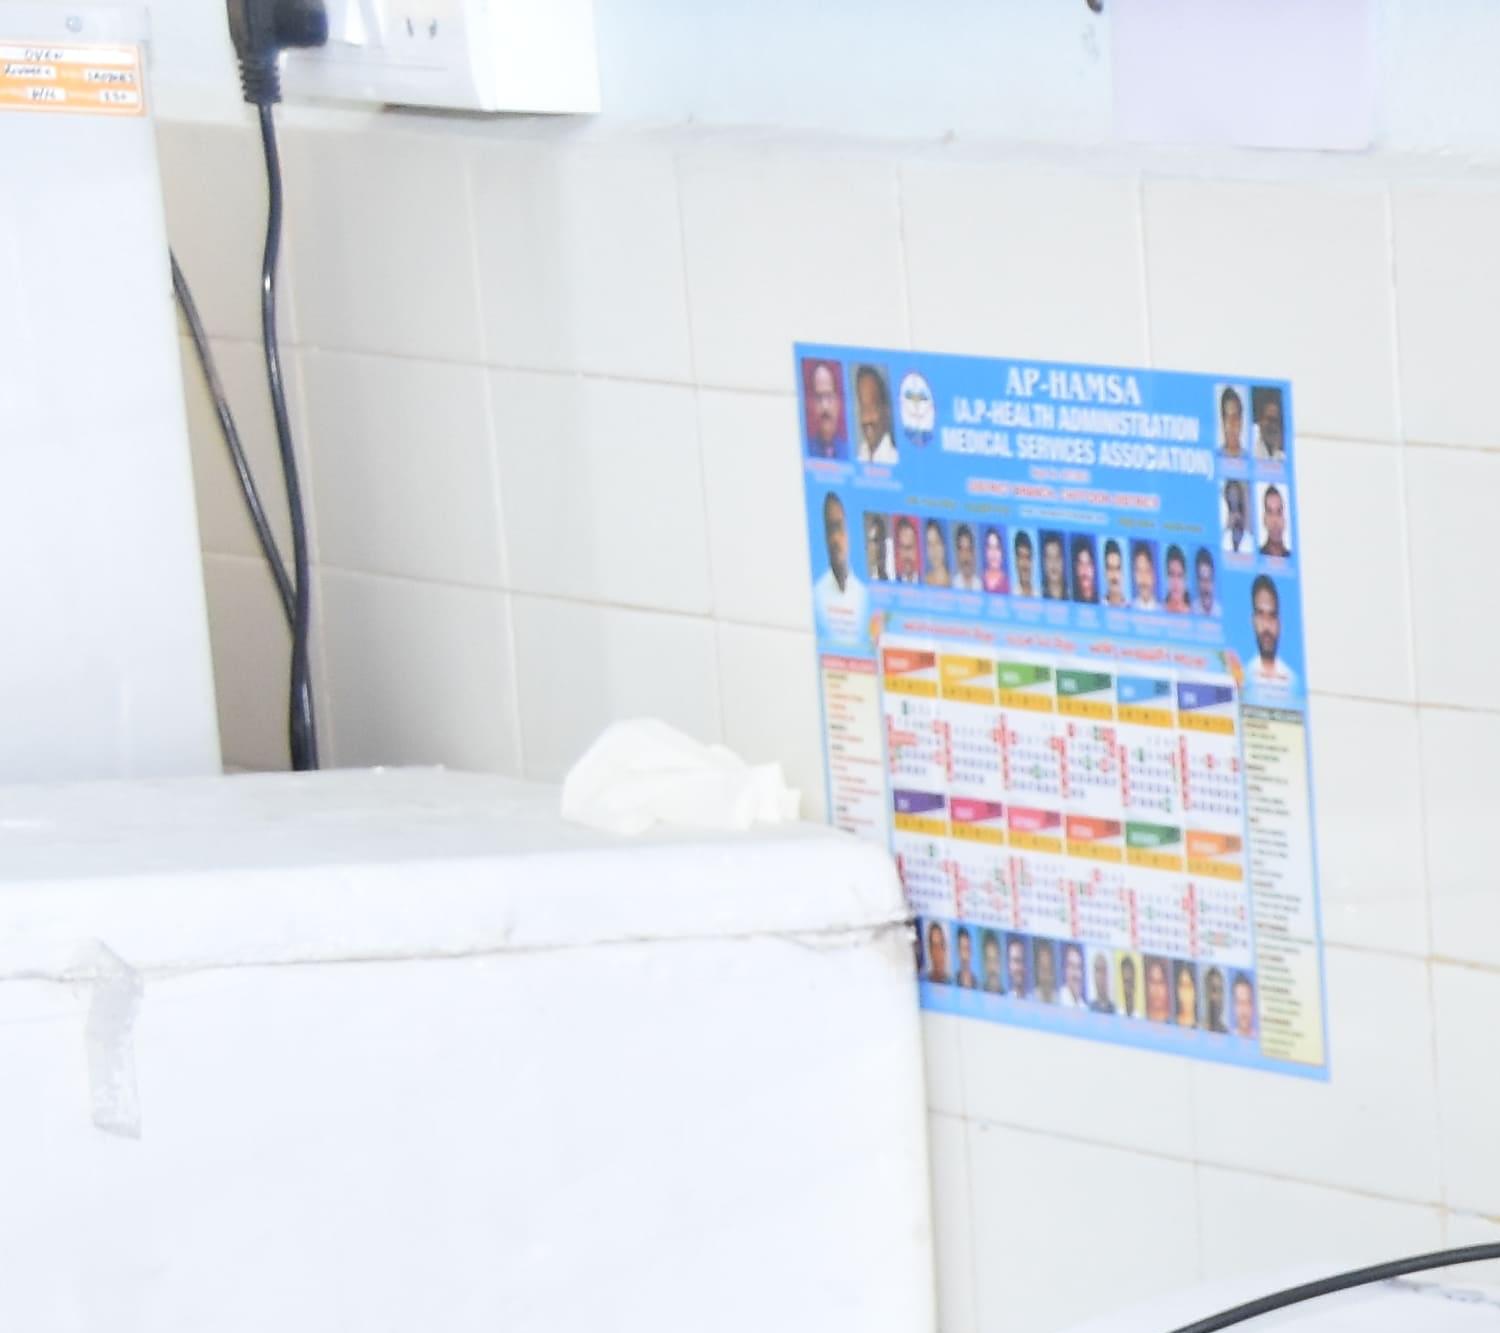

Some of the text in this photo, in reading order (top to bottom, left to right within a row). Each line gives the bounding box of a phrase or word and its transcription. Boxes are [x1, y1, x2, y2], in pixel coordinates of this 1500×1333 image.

[1006, 366, 1141, 405] AP-HAMSA
[1058, 405, 1200, 442] ADMINISTRATION
[941, 427, 1013, 458] MEDICAL
[1016, 433, 1096, 464] SERVICES
